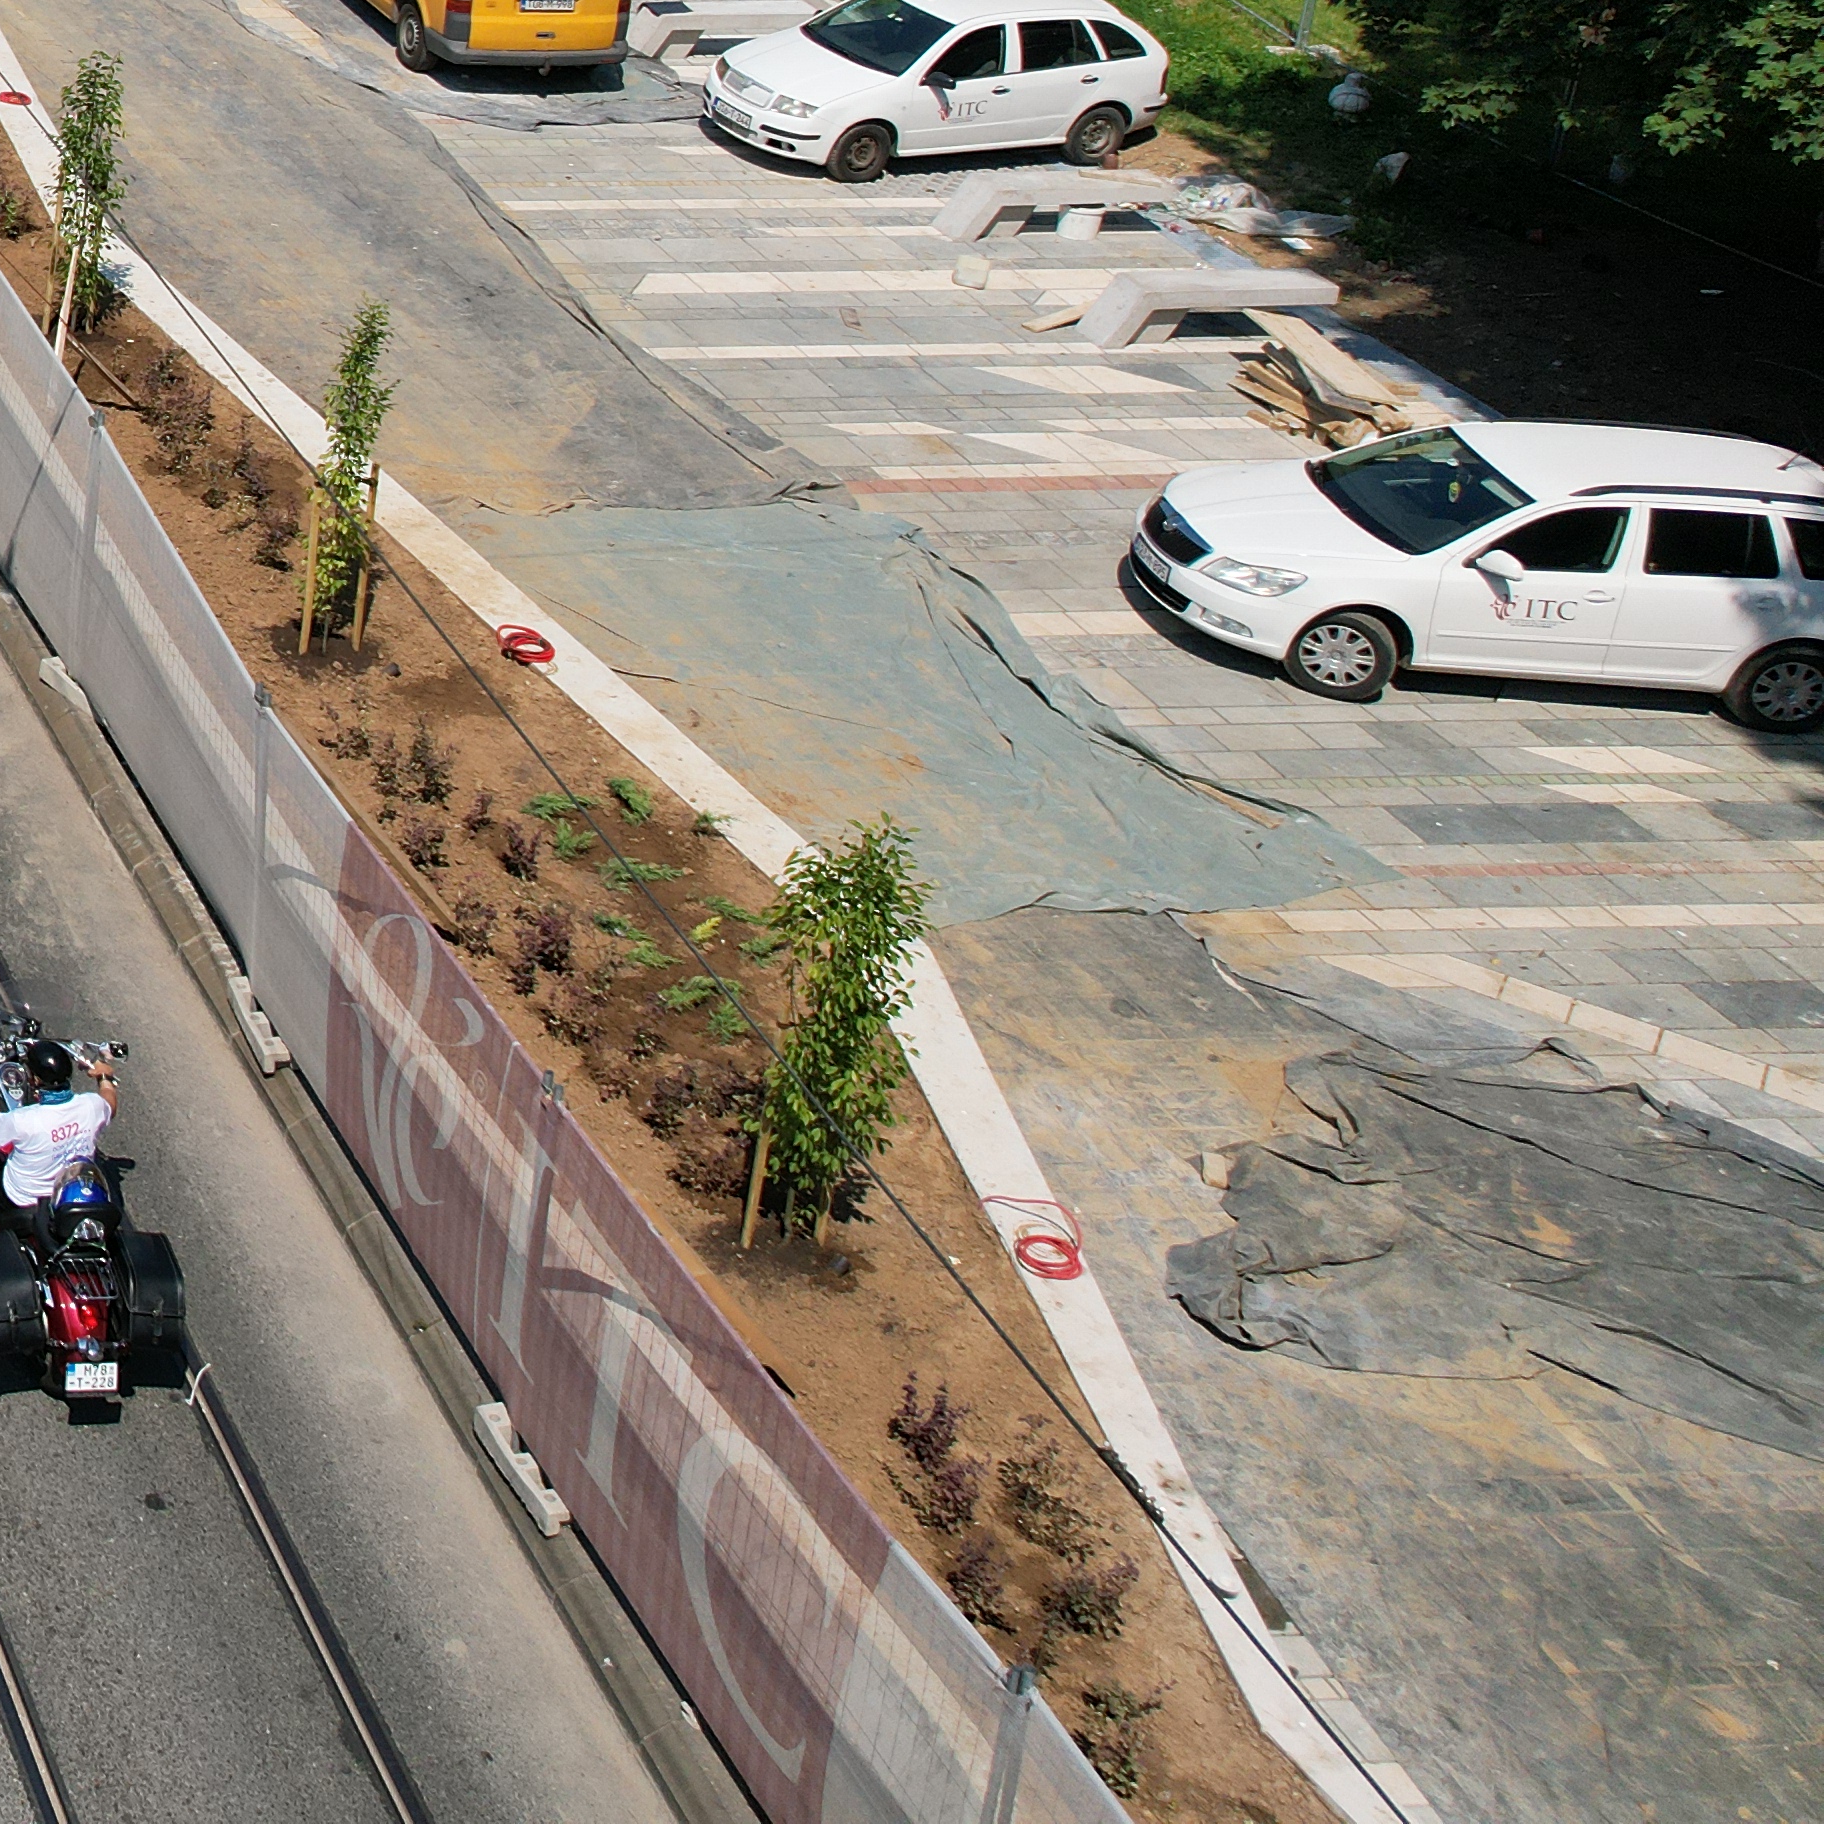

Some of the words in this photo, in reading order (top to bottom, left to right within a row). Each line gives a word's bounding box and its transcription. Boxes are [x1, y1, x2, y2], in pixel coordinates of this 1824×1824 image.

[957, 100, 988, 117] ITC
[1525, 599, 1578, 621] ITC
[488, 1124, 842, 1784] ITC
